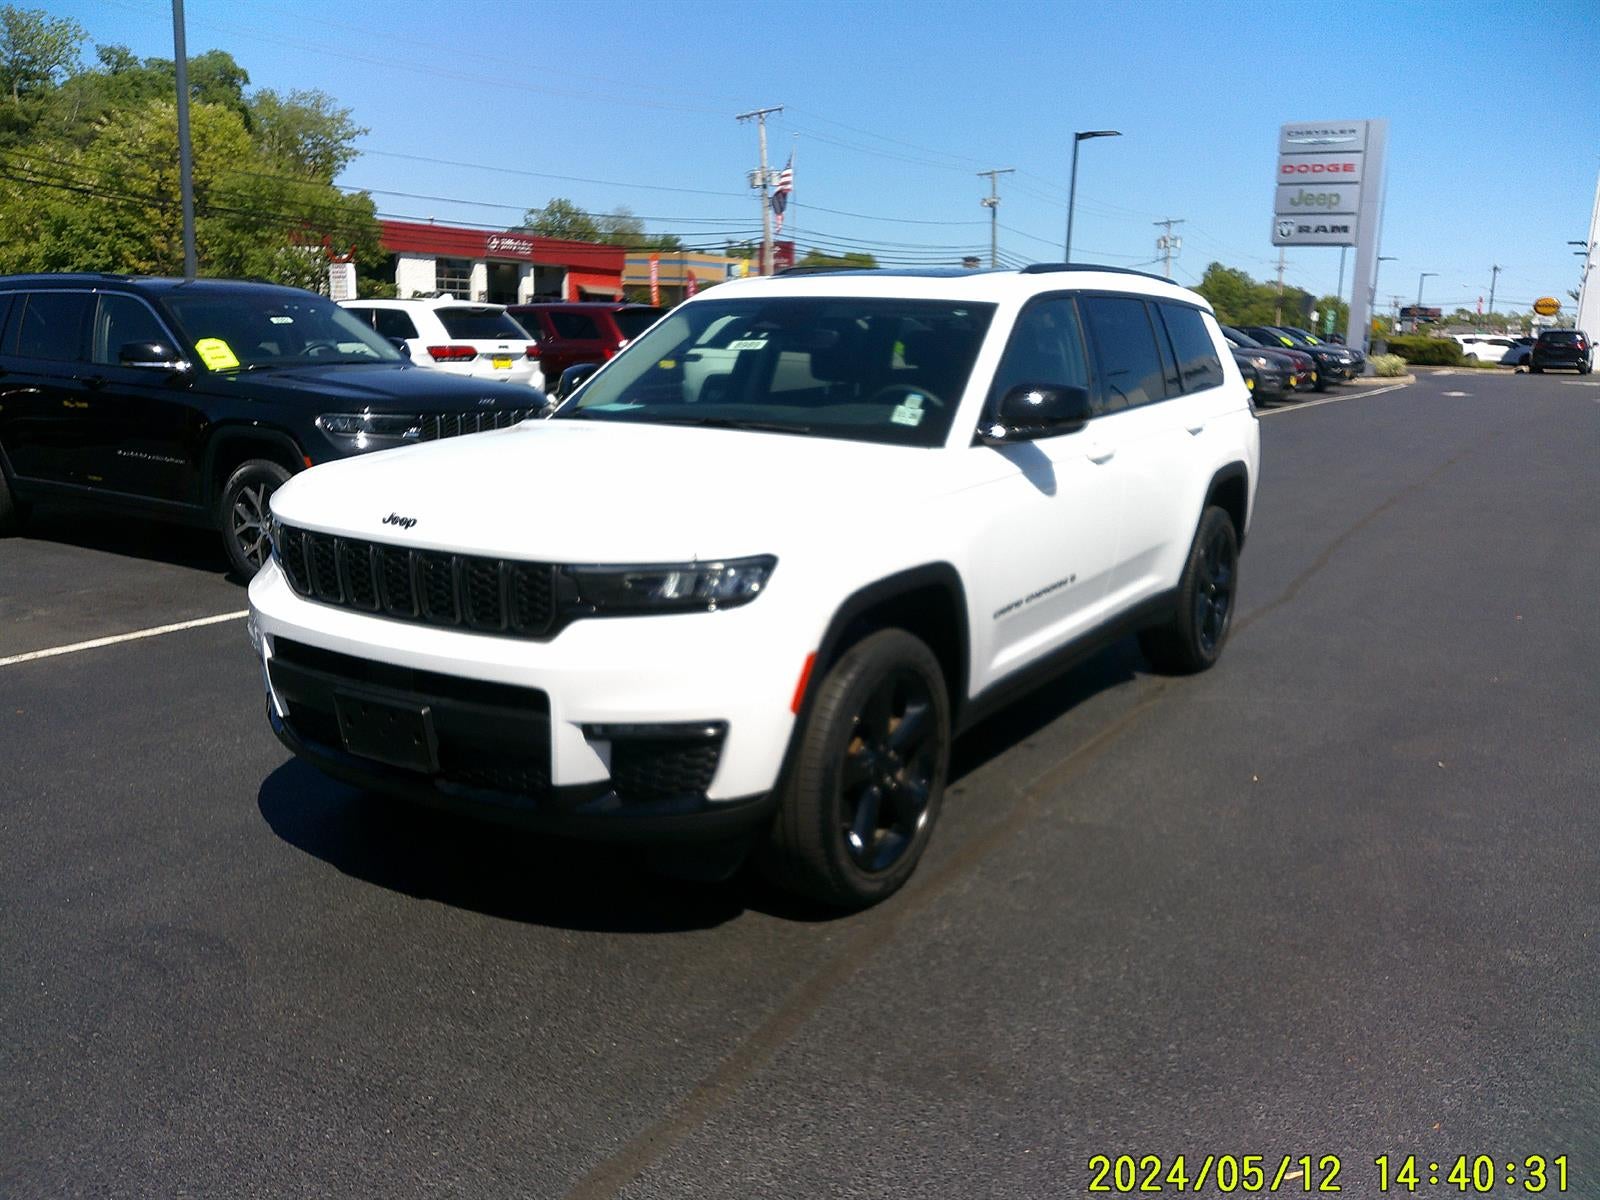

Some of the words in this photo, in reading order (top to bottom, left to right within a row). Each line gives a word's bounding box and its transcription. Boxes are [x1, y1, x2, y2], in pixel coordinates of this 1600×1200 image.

[1287, 128, 1357, 137] CHRYSLER
[1281, 163, 1356, 174] DODGE
[1290, 189, 1341, 209] Jeep
[1298, 225, 1349, 234] RAM
[382, 512, 417, 530] Jeep
